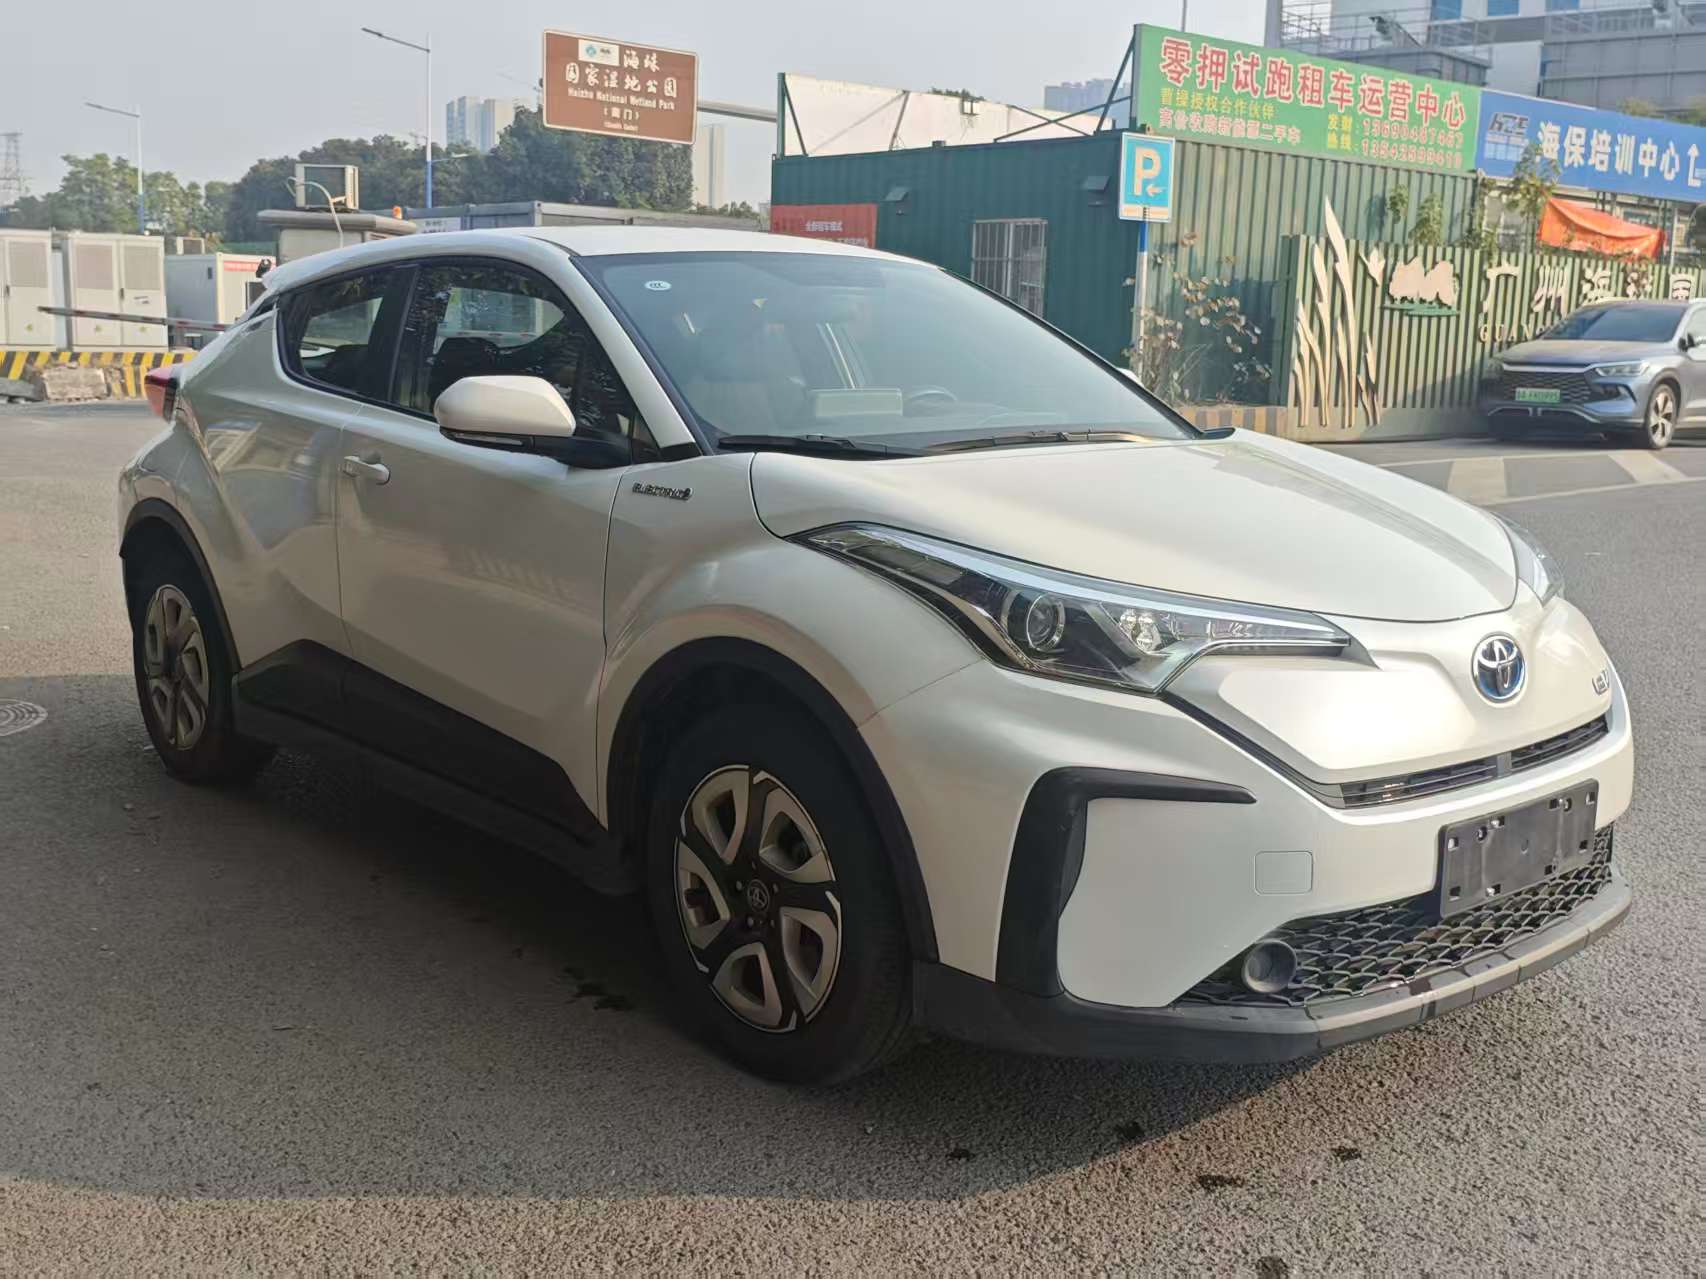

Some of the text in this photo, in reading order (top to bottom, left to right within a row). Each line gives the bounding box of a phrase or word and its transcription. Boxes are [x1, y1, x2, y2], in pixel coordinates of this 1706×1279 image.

[597, 90, 627, 104] National
[630, 95, 657, 108] Wetland
[659, 100, 675, 110] Park
[1160, 37, 1465, 129] 零押试跑租车运营中心
[1134, 147, 1161, 196] P
[1537, 121, 1680, 181] 海保培训中心
